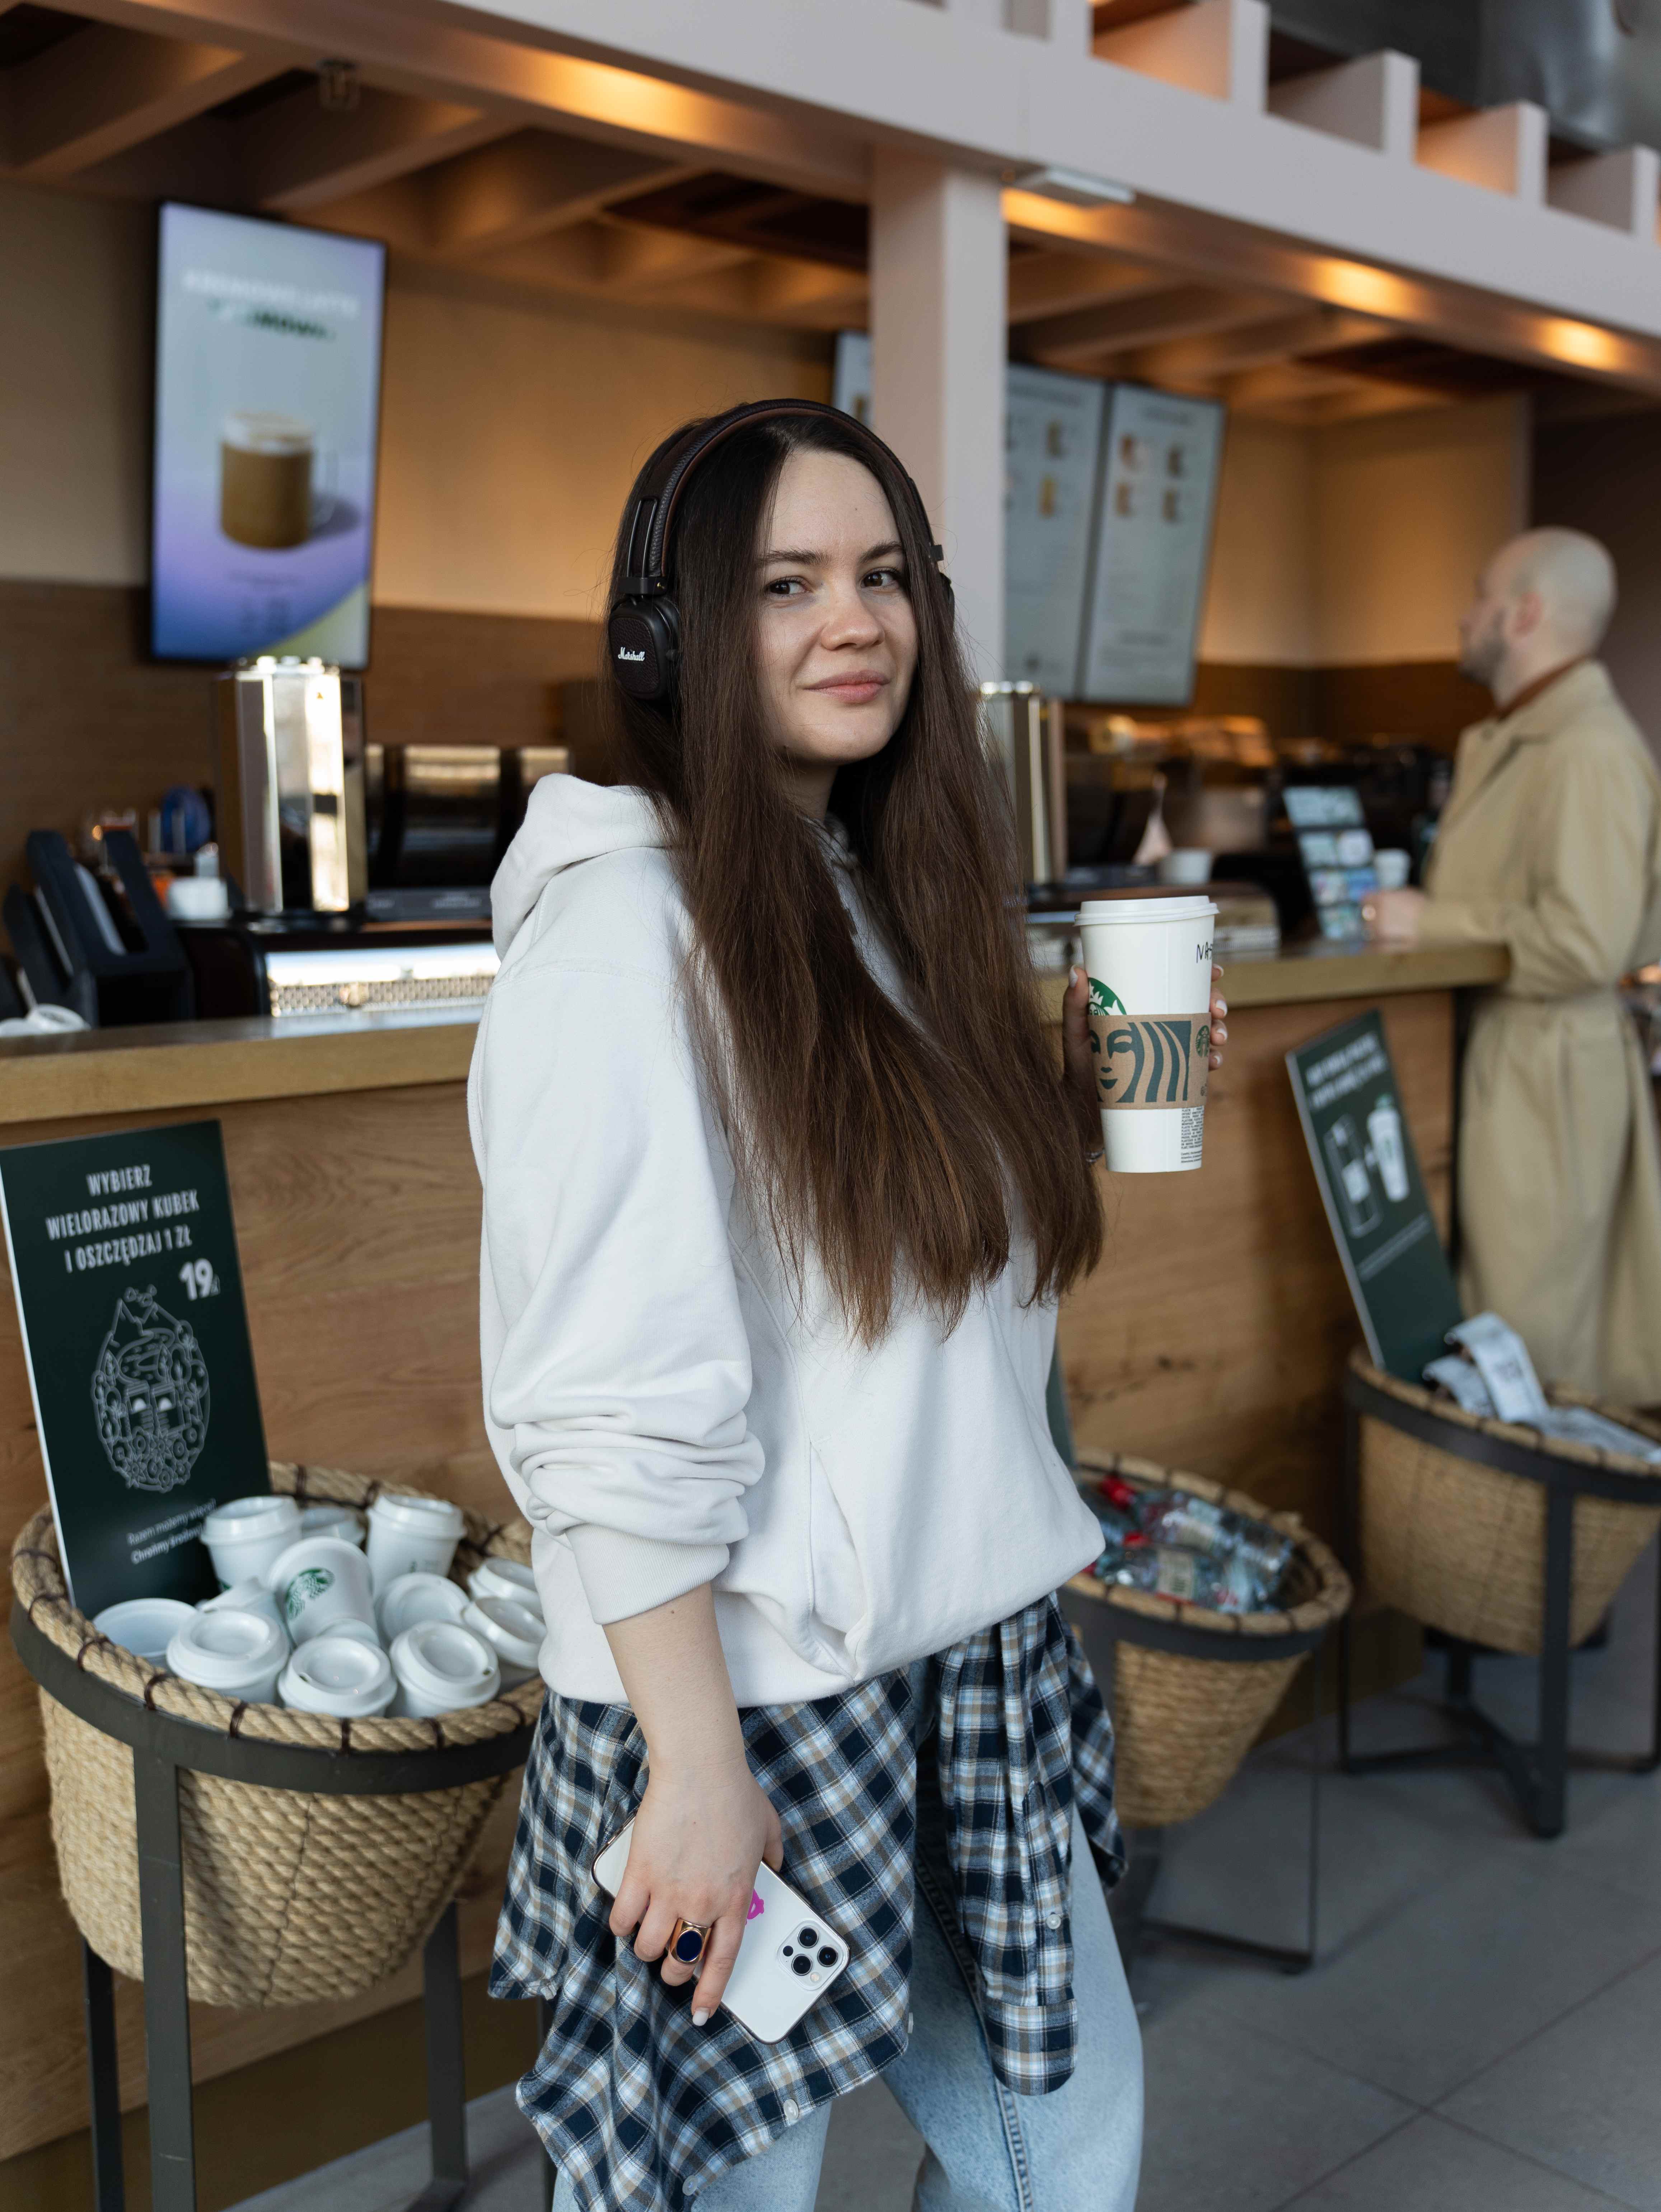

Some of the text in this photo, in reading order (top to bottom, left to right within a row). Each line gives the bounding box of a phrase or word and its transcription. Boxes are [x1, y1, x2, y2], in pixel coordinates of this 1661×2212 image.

[618, 647, 645, 661] Marshall
[86, 1164, 152, 1197] WYBIERZ
[45, 1189, 200, 1241] WIELORAZOWY KUBEK
[64, 1224, 192, 1273] I OSZCZĘDZAJ 1 ZŁ
[179, 1258, 213, 1301] 19
